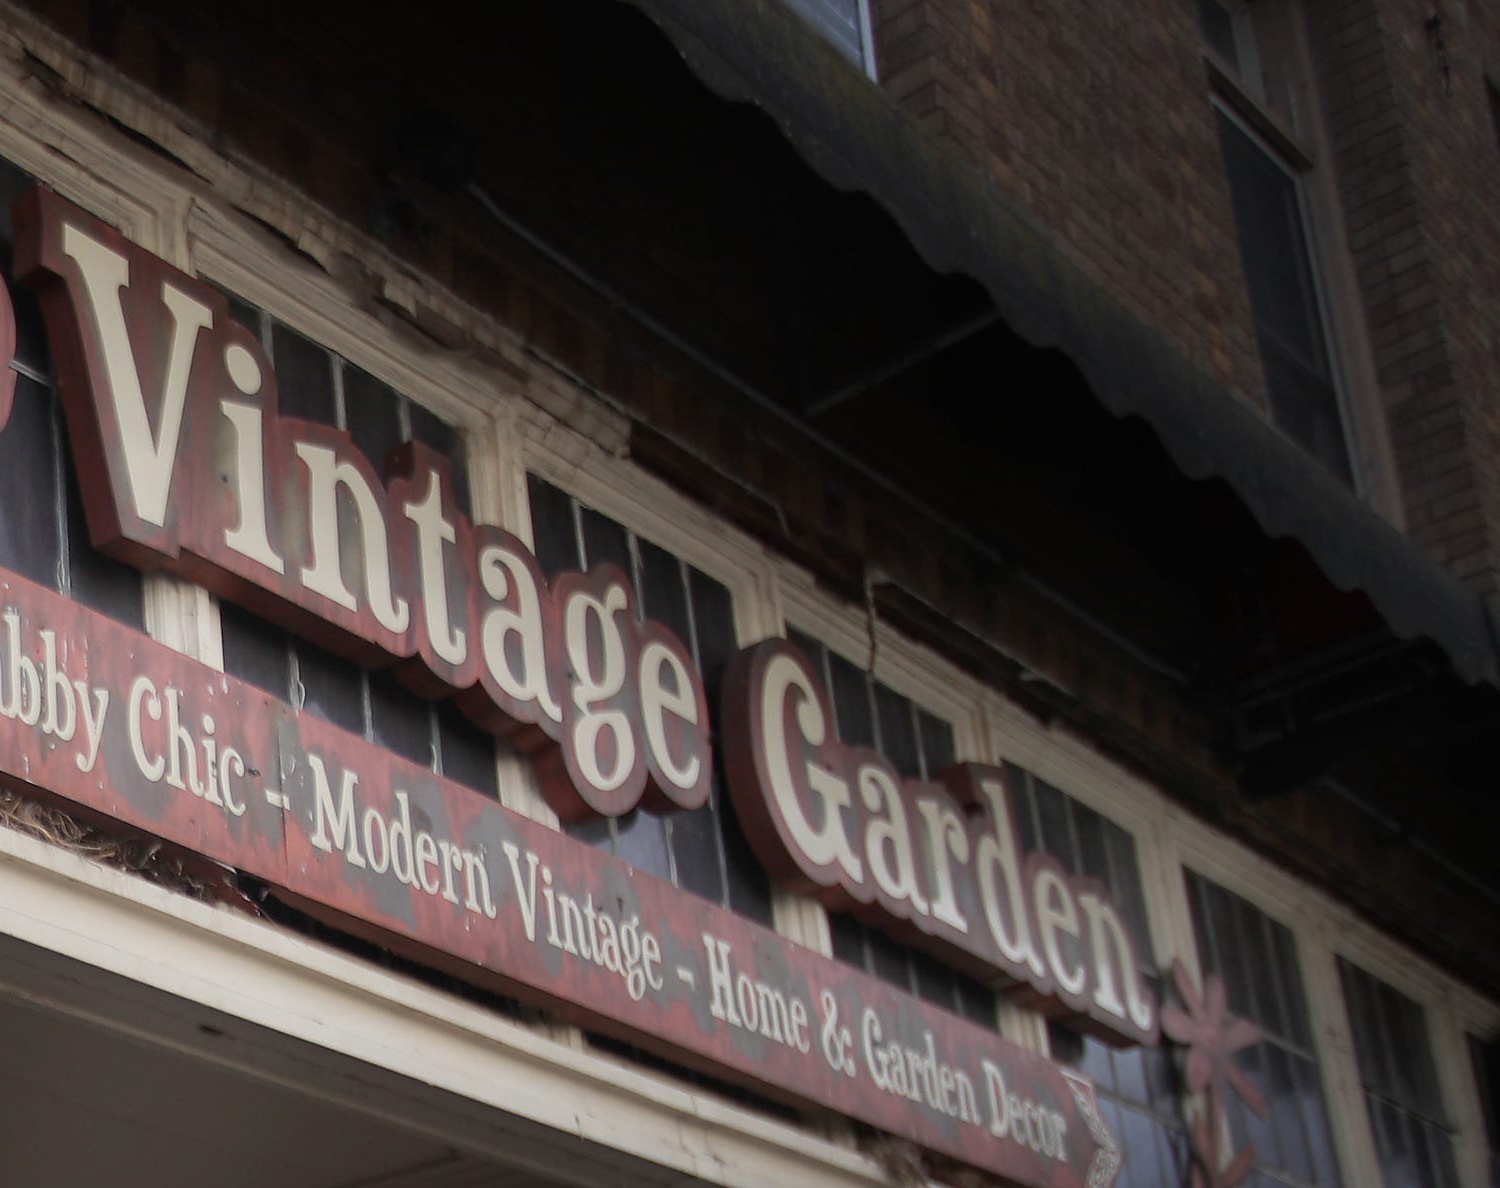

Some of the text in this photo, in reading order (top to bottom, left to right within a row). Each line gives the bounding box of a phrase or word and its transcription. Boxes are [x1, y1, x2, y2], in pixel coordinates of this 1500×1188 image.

[63, 223, 700, 792] Vintage
[760, 654, 1151, 1032] Garden
[127, 676, 245, 815] Chic
[265, 789, 290, 810] -
[308, 754, 497, 920] Modern
[503, 841, 664, 1000] Vintage
[676, 965, 695, 990] -
[703, 932, 810, 1054] Home
[820, 991, 856, 1078] &
[861, 1008, 981, 1127] Garden
[982, 1061, 1068, 1161] Decor
